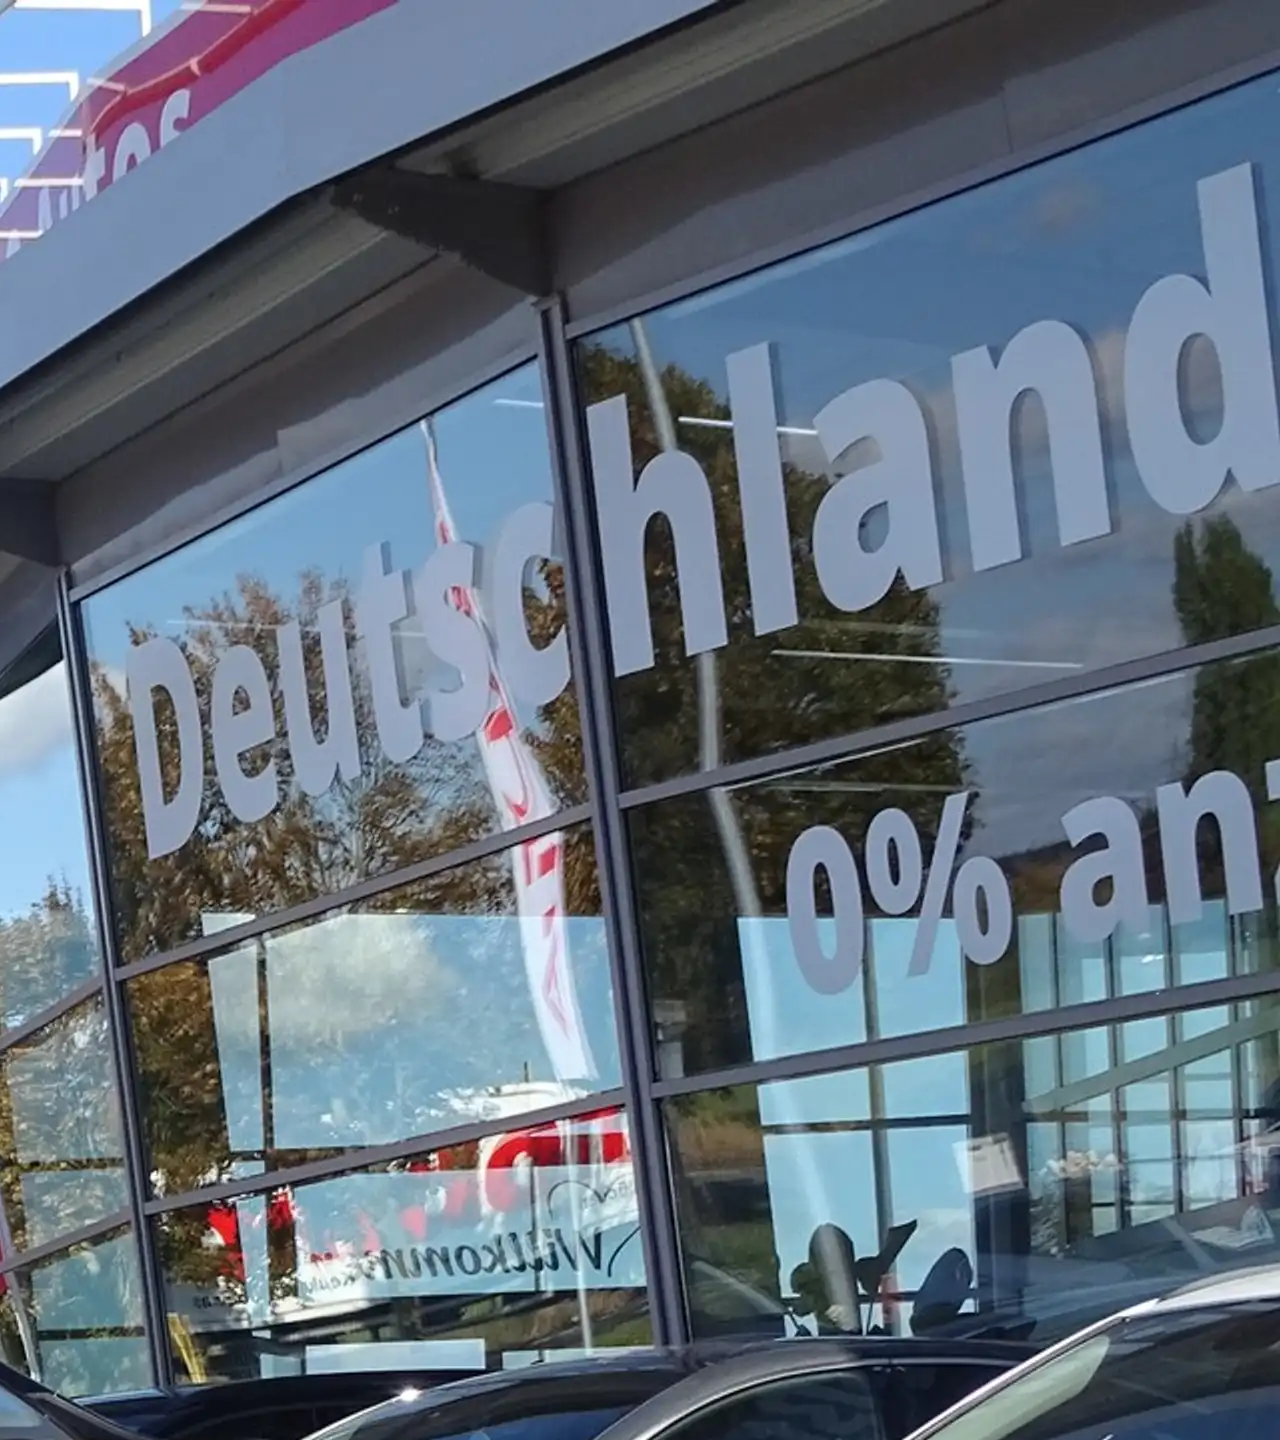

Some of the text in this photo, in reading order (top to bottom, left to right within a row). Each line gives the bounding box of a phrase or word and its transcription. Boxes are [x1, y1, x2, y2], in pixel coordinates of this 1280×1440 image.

[125, 161, 1280, 859] Deutschland
[786, 758, 1280, 996] 0% an
